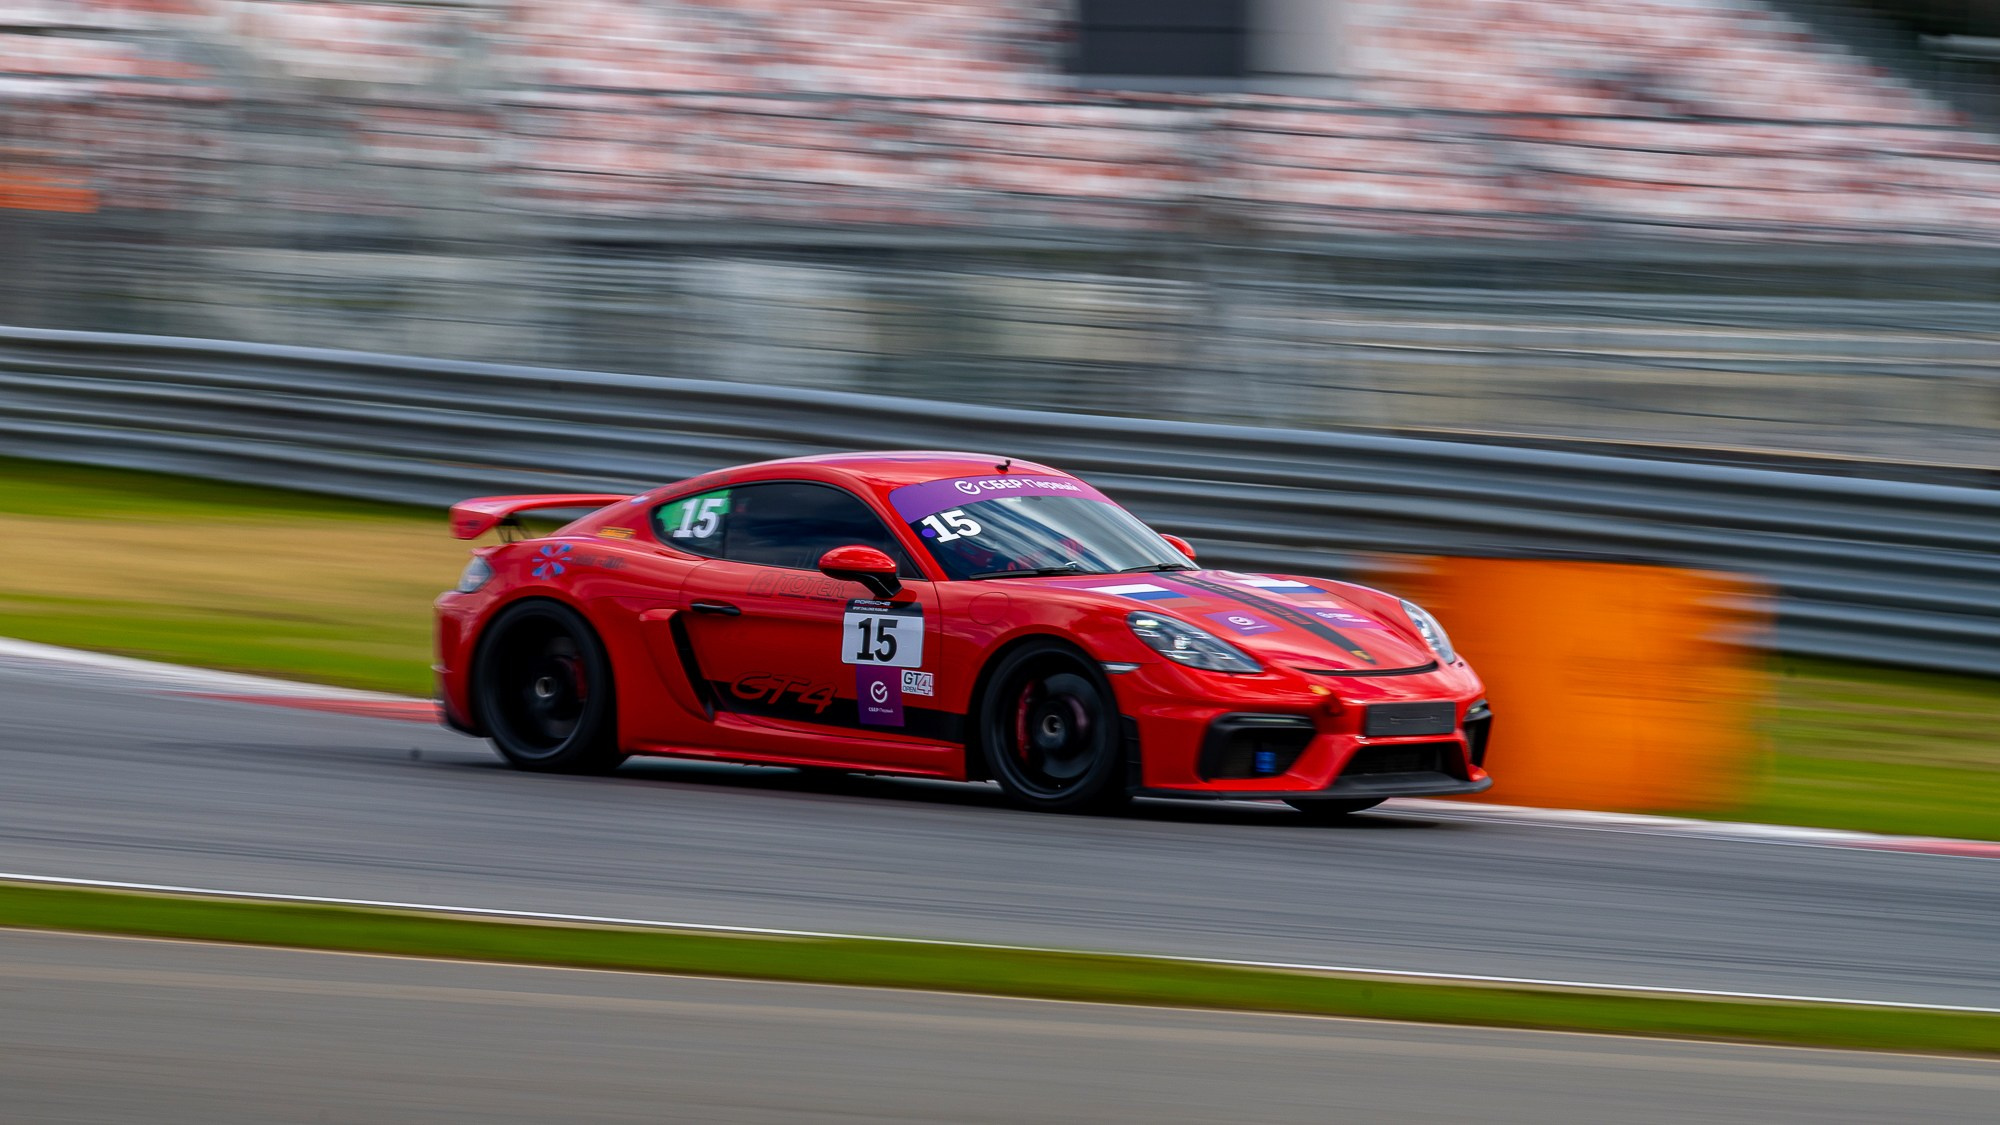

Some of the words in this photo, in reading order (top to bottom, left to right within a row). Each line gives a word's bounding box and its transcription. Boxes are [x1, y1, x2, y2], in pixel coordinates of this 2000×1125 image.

[979, 479, 1022, 490] СБЕР
[1025, 479, 1081, 492] Первый
[673, 499, 724, 538] 15
[921, 510, 982, 543] 15
[857, 618, 898, 662] 15
[730, 671, 838, 714] GT4
[903, 672, 933, 694] GT4
